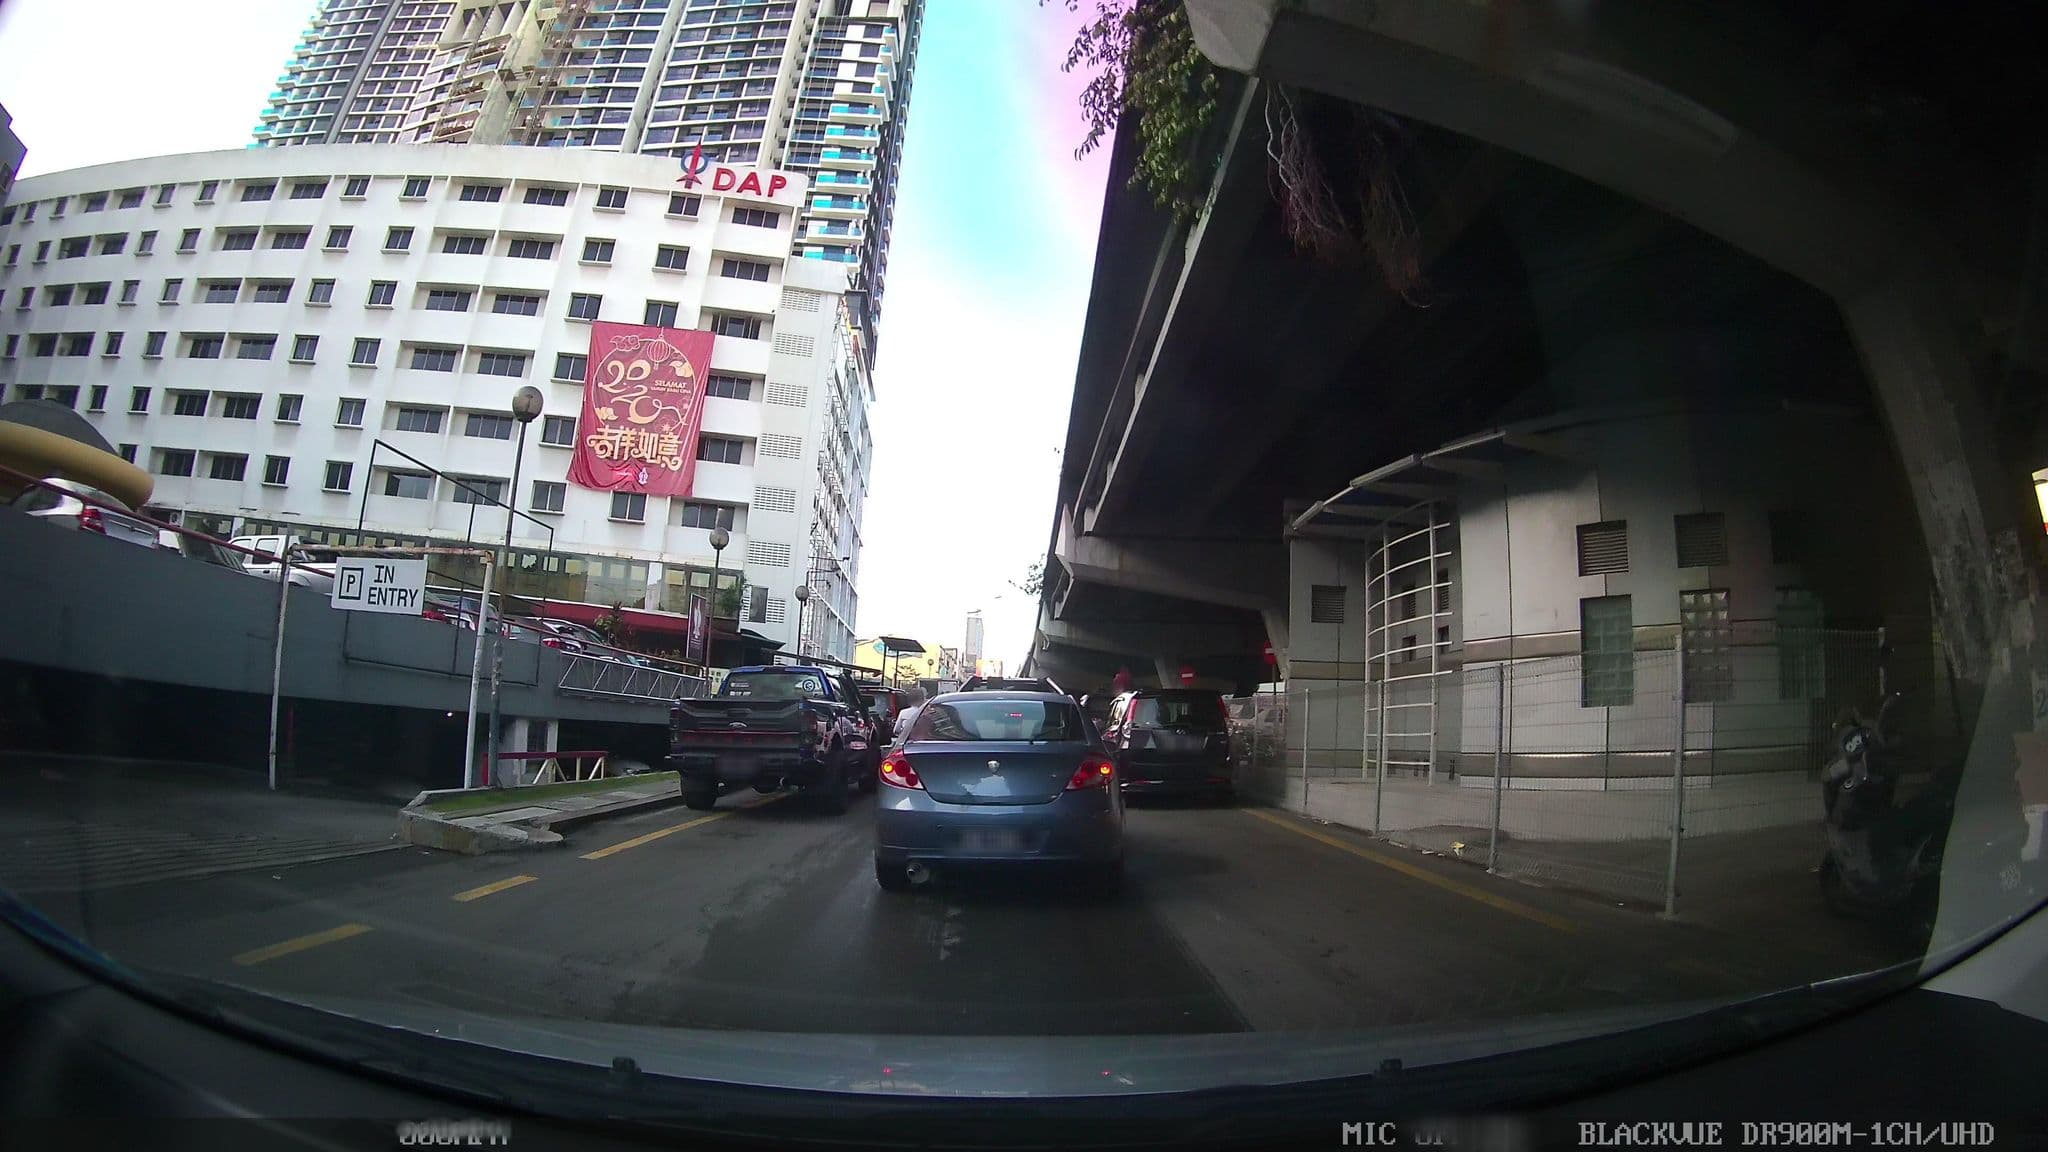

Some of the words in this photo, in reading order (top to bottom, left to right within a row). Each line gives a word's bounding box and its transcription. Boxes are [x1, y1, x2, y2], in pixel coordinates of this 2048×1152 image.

[712, 167, 787, 198] DAP
[654, 380, 687, 389] SELAMAT
[587, 425, 683, 471] 吉祥如意
[346, 574, 356, 593] P
[373, 564, 395, 584] IN
[367, 586, 418, 608] ENTRY
